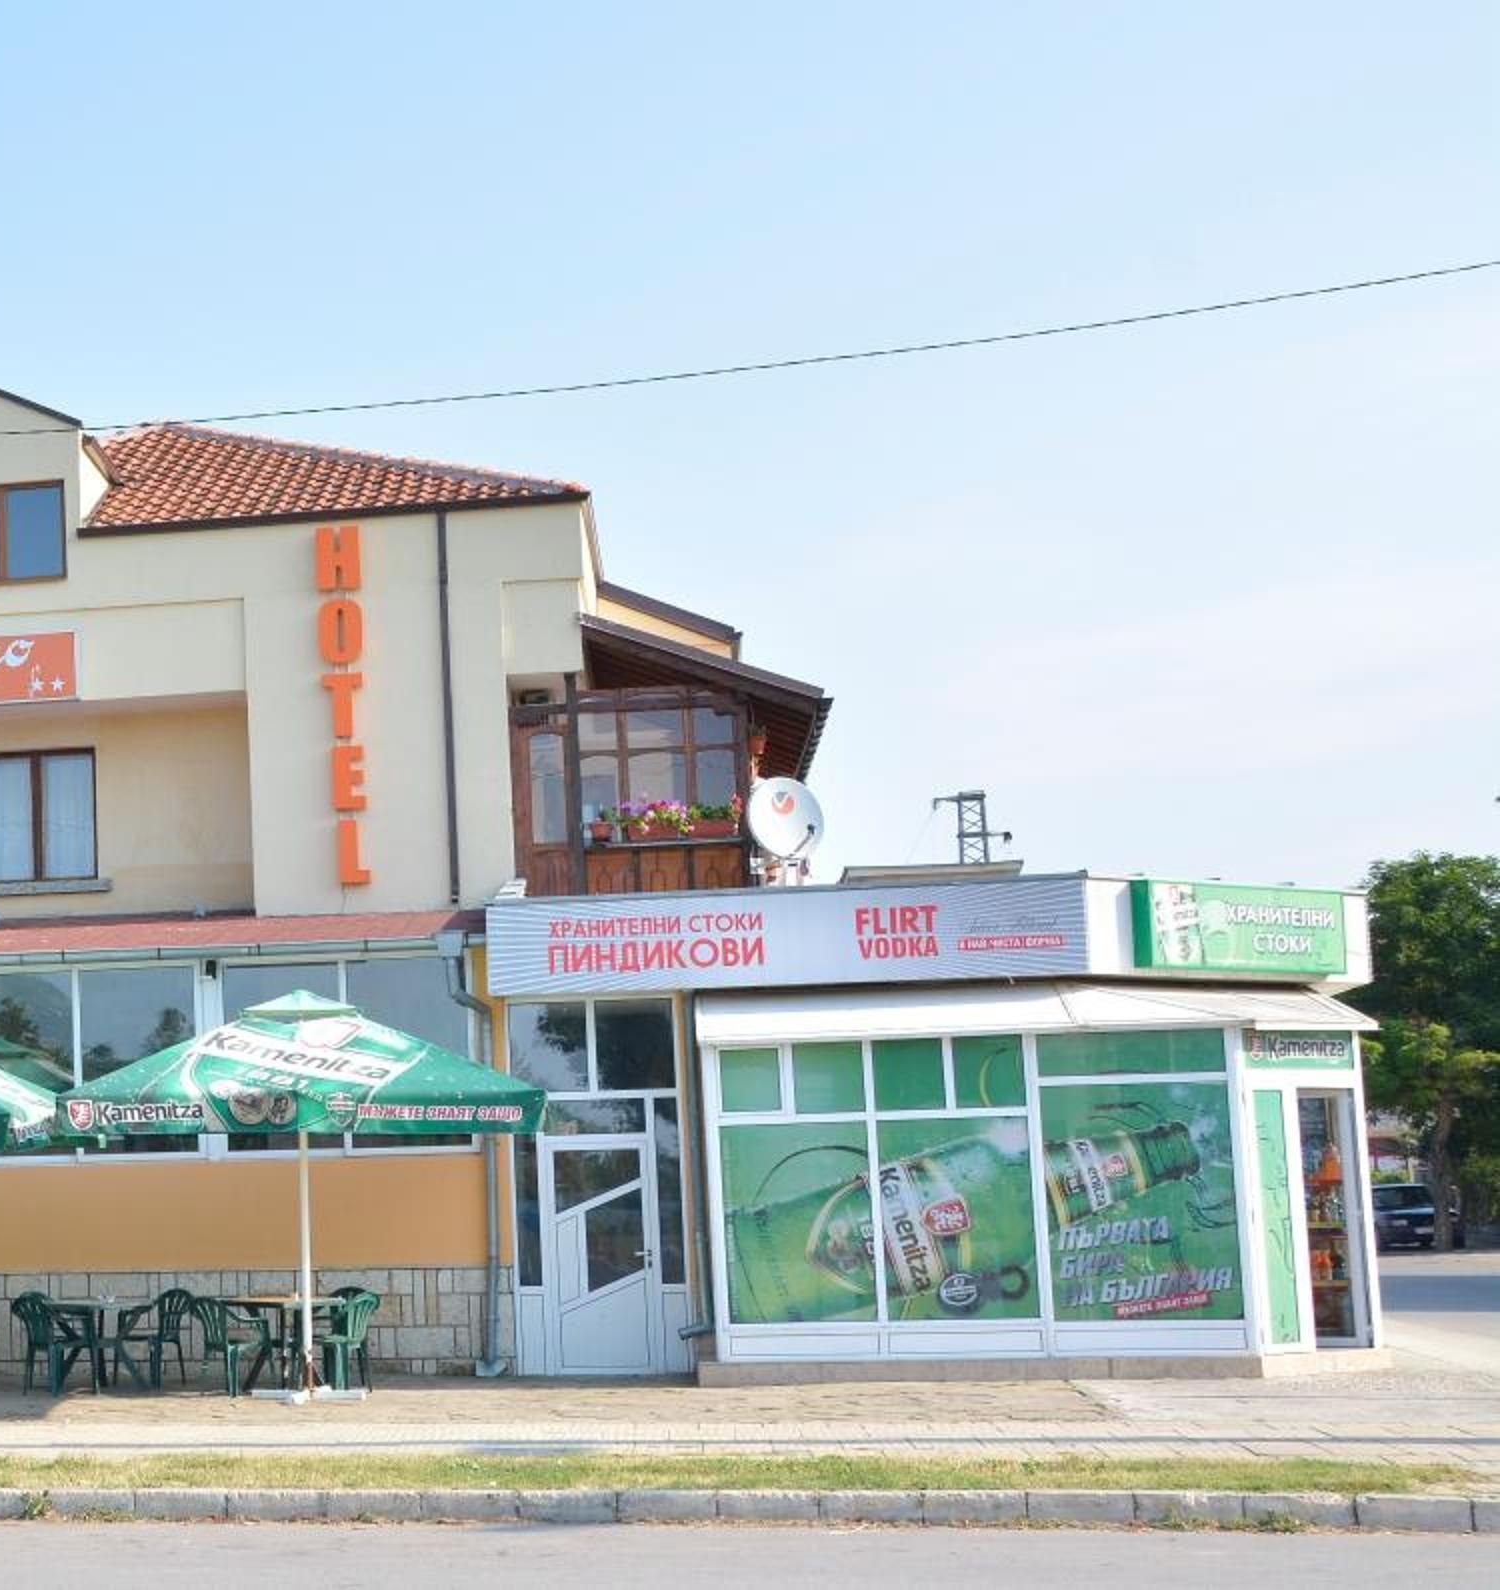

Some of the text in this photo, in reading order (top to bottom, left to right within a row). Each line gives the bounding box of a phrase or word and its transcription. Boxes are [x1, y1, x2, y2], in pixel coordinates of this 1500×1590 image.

[315, 526, 371, 885] HOTEL
[550, 912, 763, 939] ХРАНИТЕЛНИ СТОКИ
[855, 904, 938, 935] FLIRT
[1226, 904, 1334, 929] ХРАНИТЕЛНИ
[548, 937, 765, 975] ПИНДИКОВИ
[858, 936, 939, 960] VODKA
[1253, 934, 1313, 956] СТОКИ
[1267, 1036, 1345, 1059] Kamenitza
[98, 1102, 203, 1123] Kamenitza
[426, 1105, 476, 1121] ЗНАЯТ
[1059, 1216, 1171, 1251] ПЪРВАТА
[1101, 1266, 1233, 1303] БЪЛГАРИЯ
